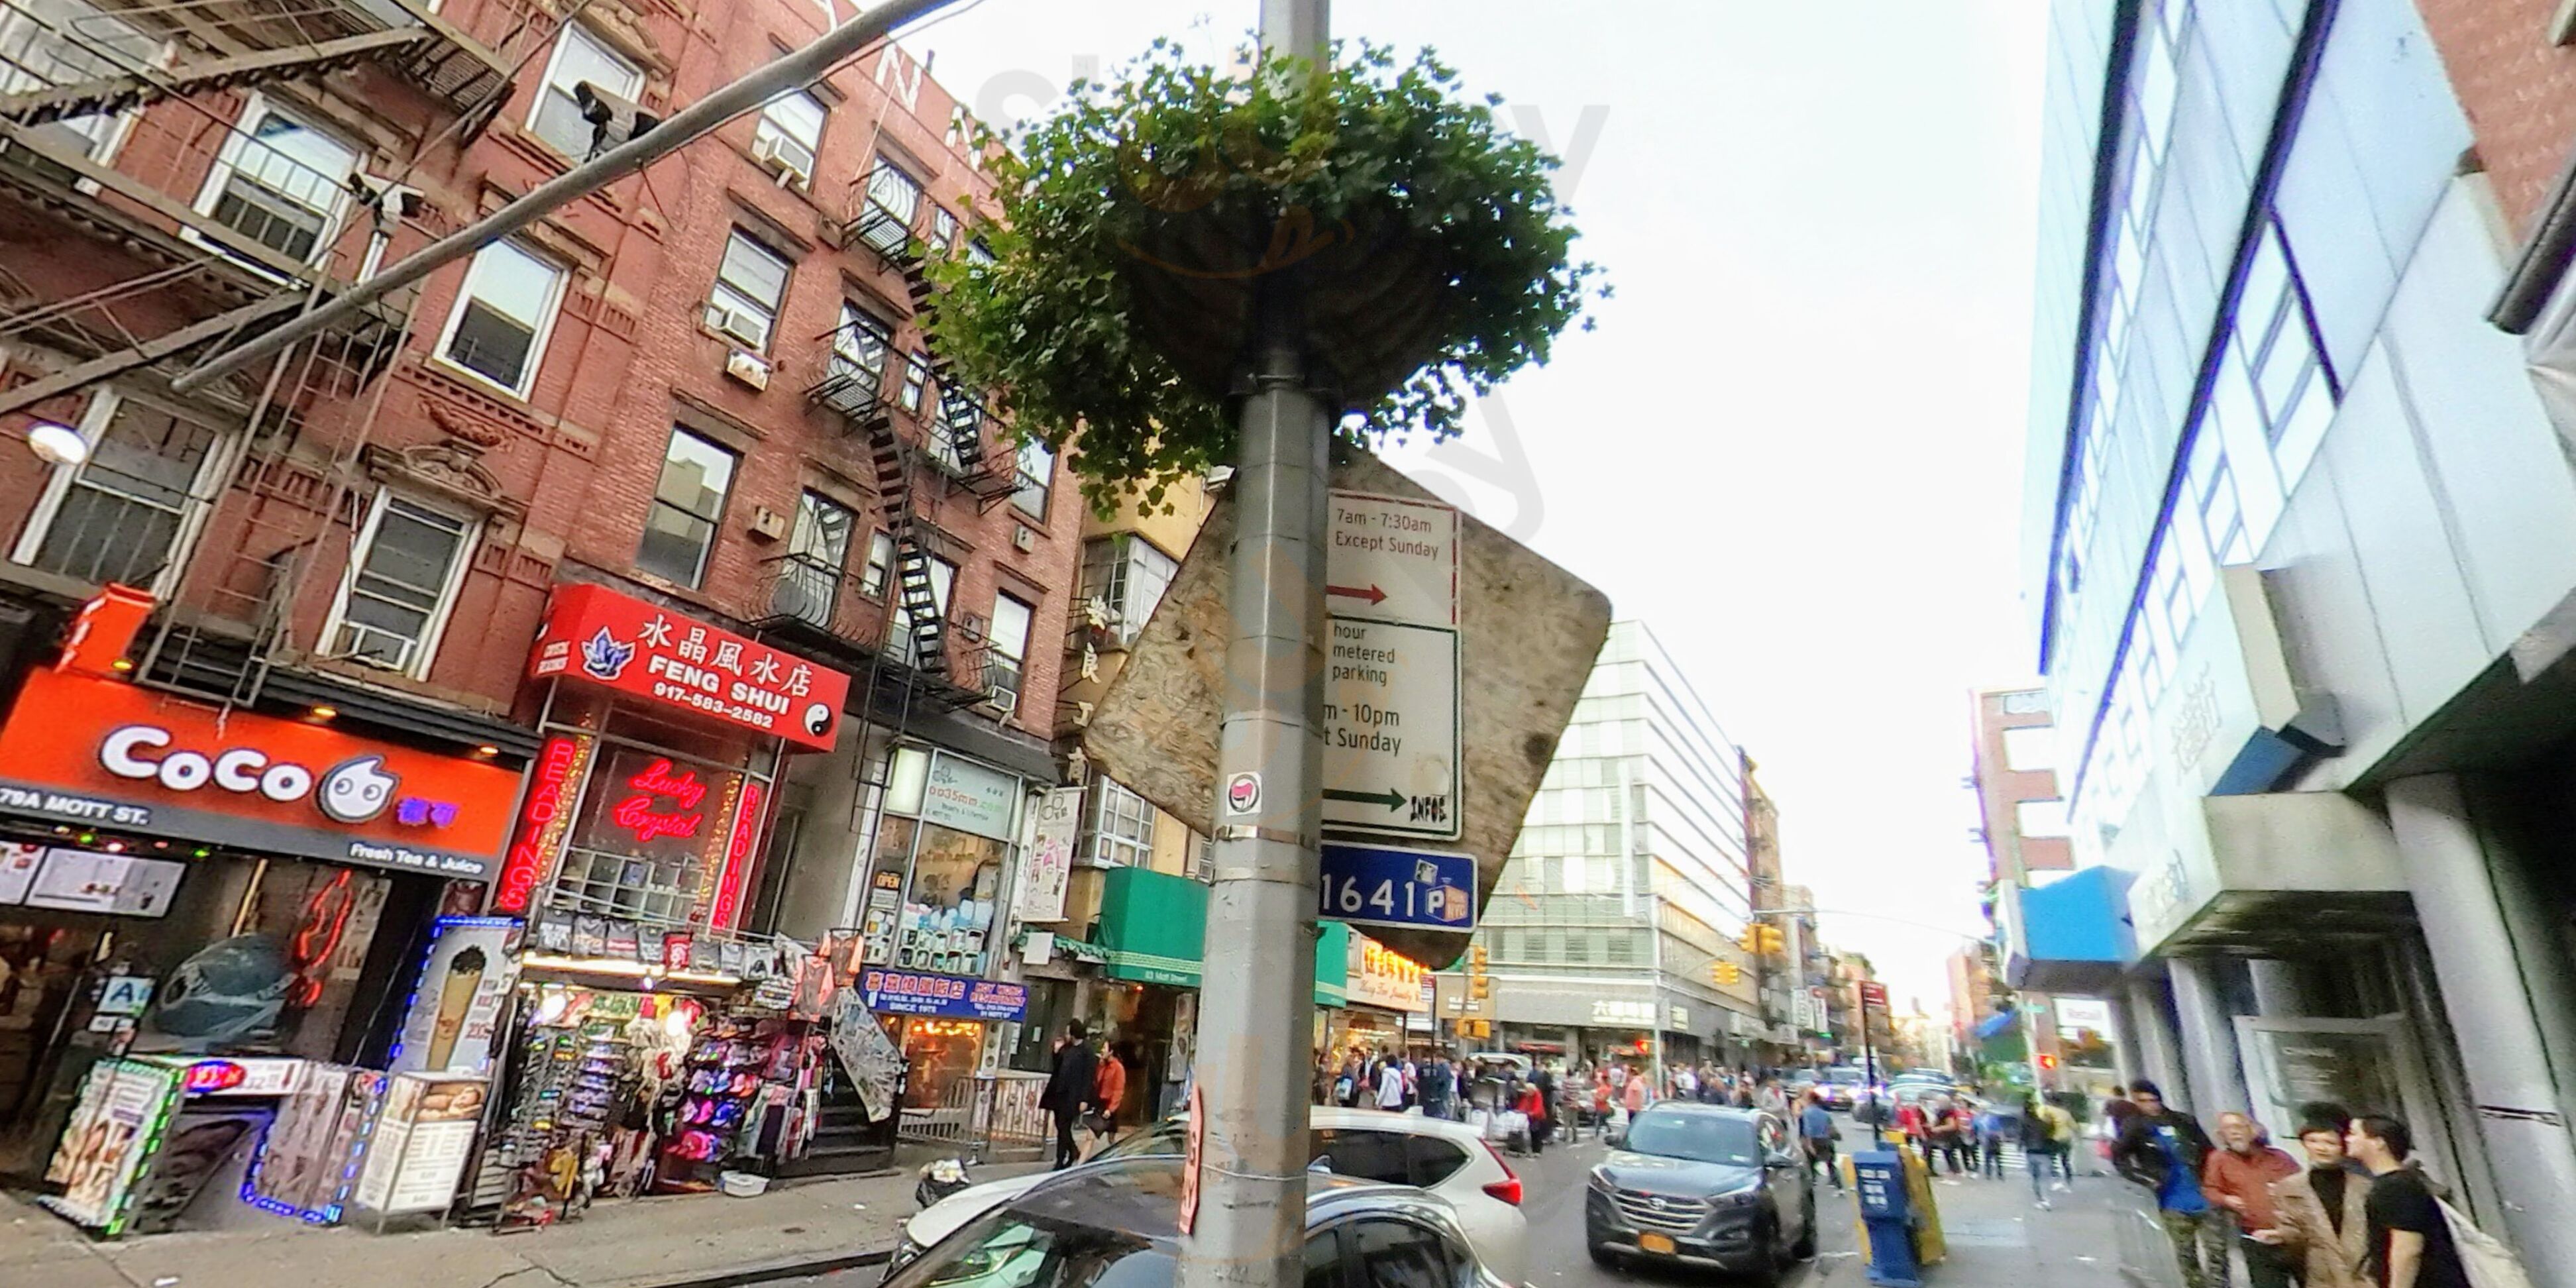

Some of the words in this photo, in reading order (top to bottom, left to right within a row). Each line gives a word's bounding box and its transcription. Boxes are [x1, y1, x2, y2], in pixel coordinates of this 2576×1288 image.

[1336, 508, 1367, 525] 7am
[1380, 512, 1432, 533] 7:30am
[1336, 531, 1384, 553] Except
[1388, 538, 1439, 561] Sunday
[1334, 622, 1368, 639] hour
[638, 614, 815, 698] 水晶風水店
[1332, 643, 1395, 663] metered
[647, 655, 720, 691] FENG
[730, 681, 791, 715] SHUI
[1332, 665, 1387, 686] parking
[653, 682, 773, 729] 917-583-2582
[1354, 704, 1400, 728] 10pm
[1337, 728, 1402, 757] Sunday
[101, 725, 312, 802] CoCo
[633, 759, 705, 808] Lucky
[0, 788, 40, 810] 79A
[44, 794, 112, 820] MOTT
[113, 806, 150, 826] ST.
[616, 796, 701, 839] Crystal
[505, 741, 575, 909] READINGS
[350, 842, 393, 862] Fresh
[396, 849, 421, 867] Tea
[425, 853, 438, 869] &
[441, 857, 484, 875] Juice
[714, 787, 759, 930] READINGS
[877, 874, 900, 888] OPEN
[1321, 873, 1417, 918] 1641
[109, 981, 134, 1002] A
